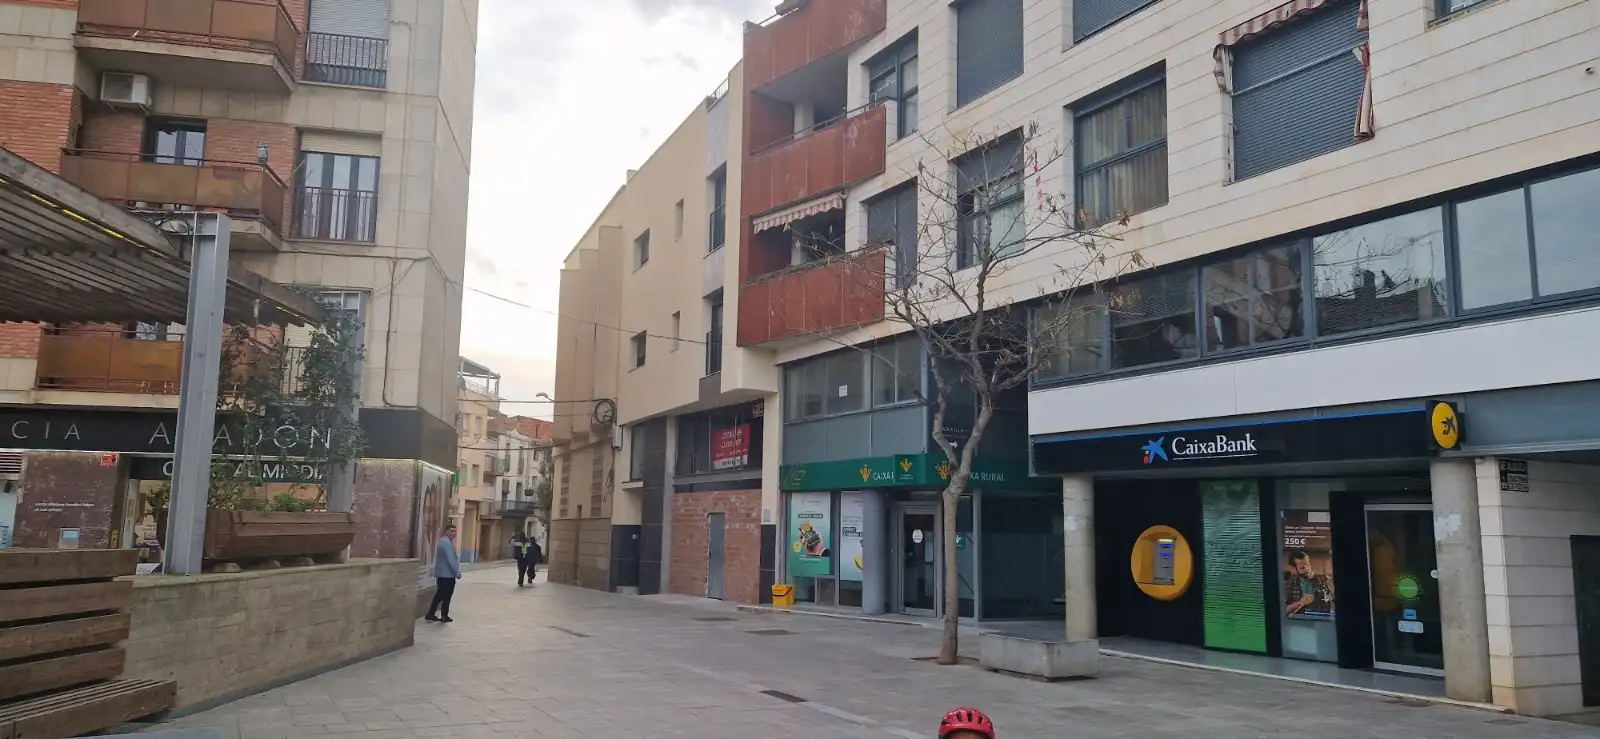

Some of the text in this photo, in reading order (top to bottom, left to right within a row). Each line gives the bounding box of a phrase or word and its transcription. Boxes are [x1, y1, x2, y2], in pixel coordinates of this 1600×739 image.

[1171, 432, 1258, 455] CaixaBank
[872, 471, 891, 481] CAIXA
[981, 472, 1006, 482] RURAL
